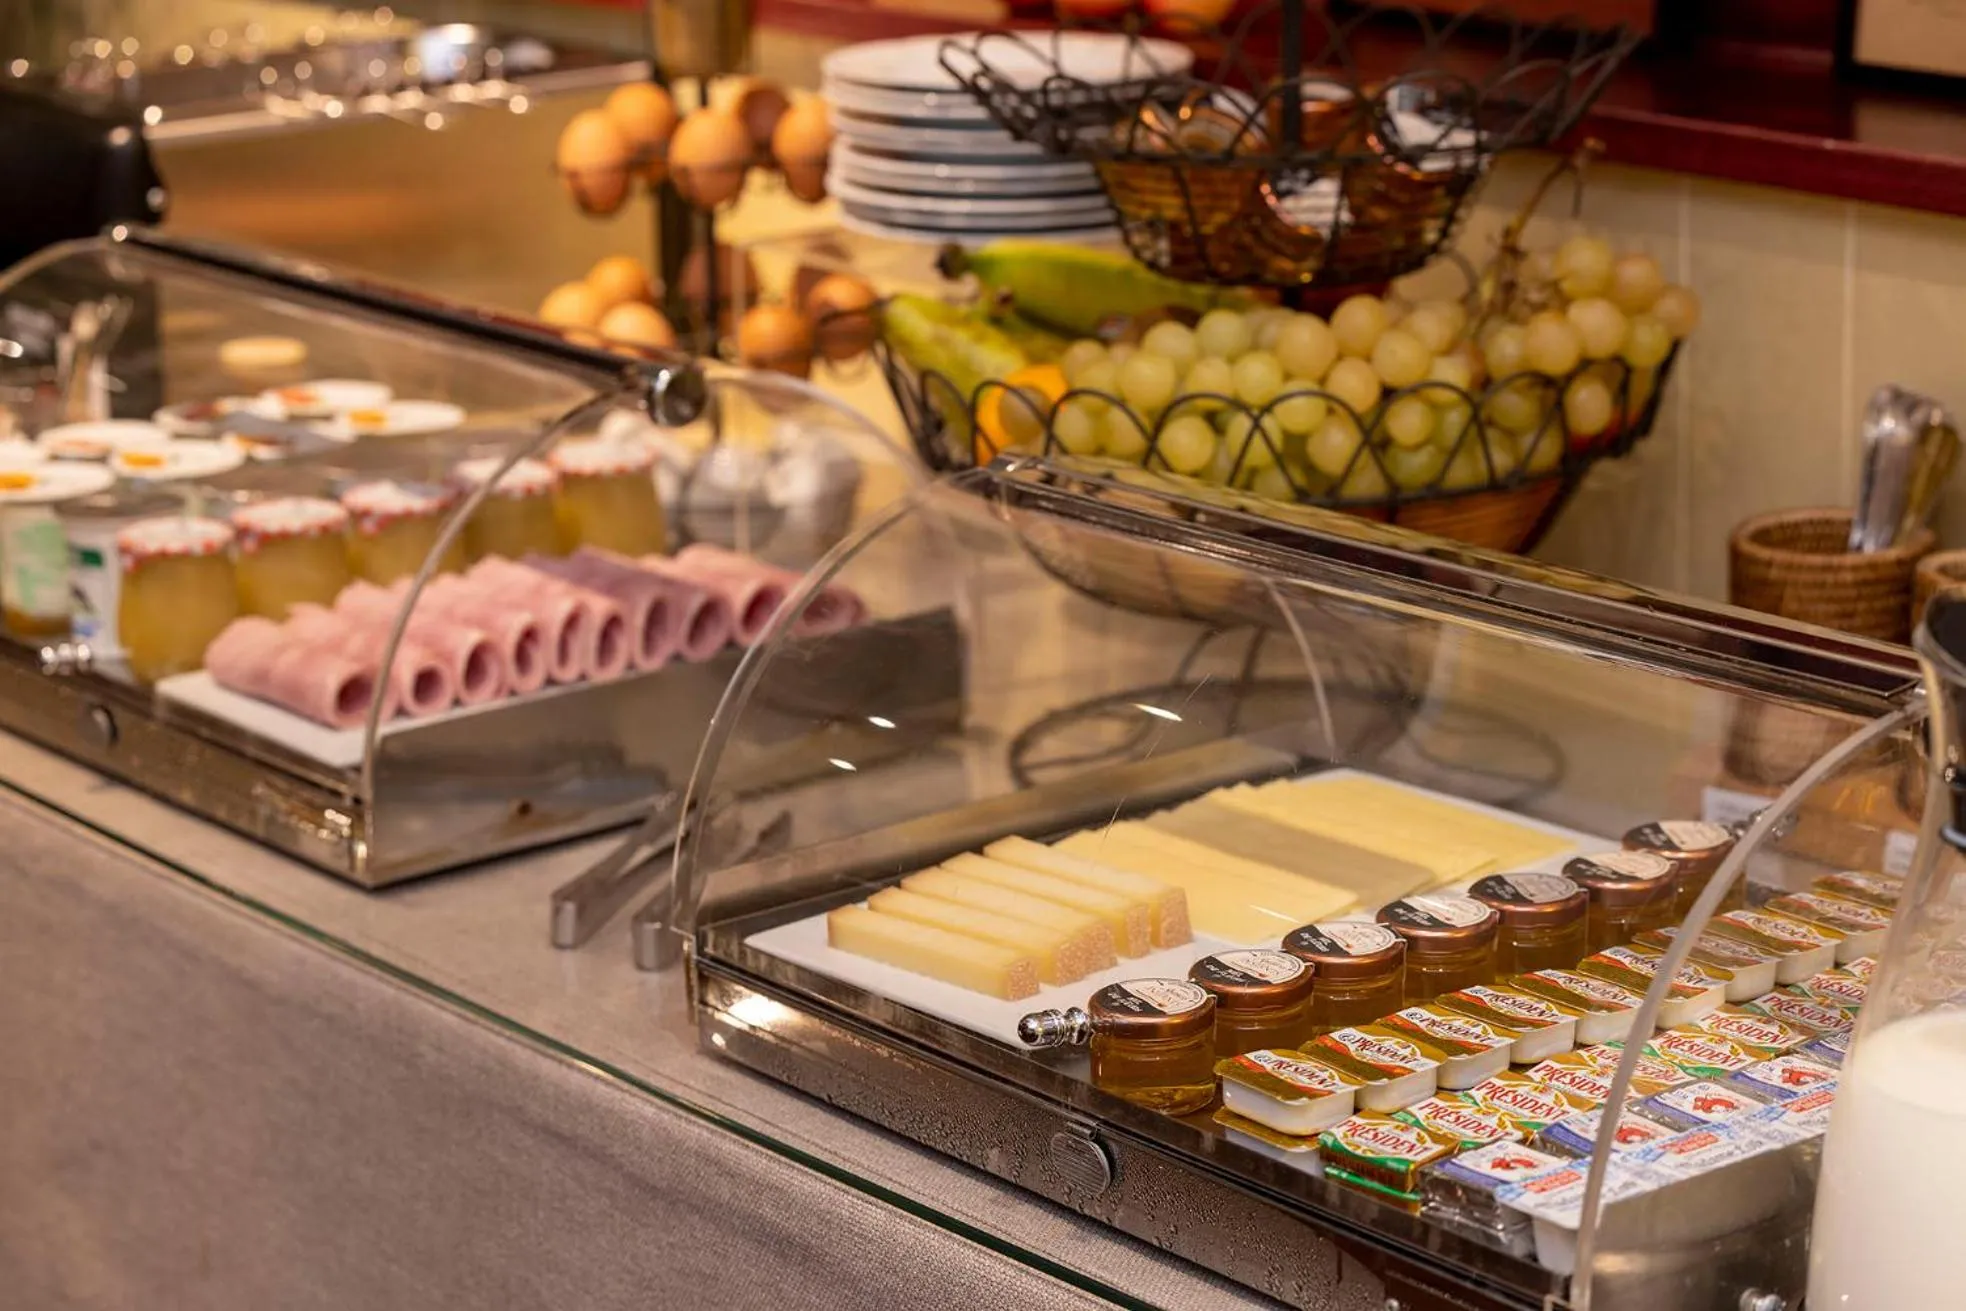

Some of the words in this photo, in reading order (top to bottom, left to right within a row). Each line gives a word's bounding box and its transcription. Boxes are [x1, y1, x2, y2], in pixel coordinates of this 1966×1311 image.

[1701, 1013, 1790, 1045] PRÉSIDENT
[1656, 1034, 1743, 1067] PRÉSIDENT
[1475, 1080, 1571, 1121] PRÉSIDENT
[1337, 1119, 1434, 1156] PRÉSIDENT
[1418, 1101, 1513, 1139] PRÉSIDENT
